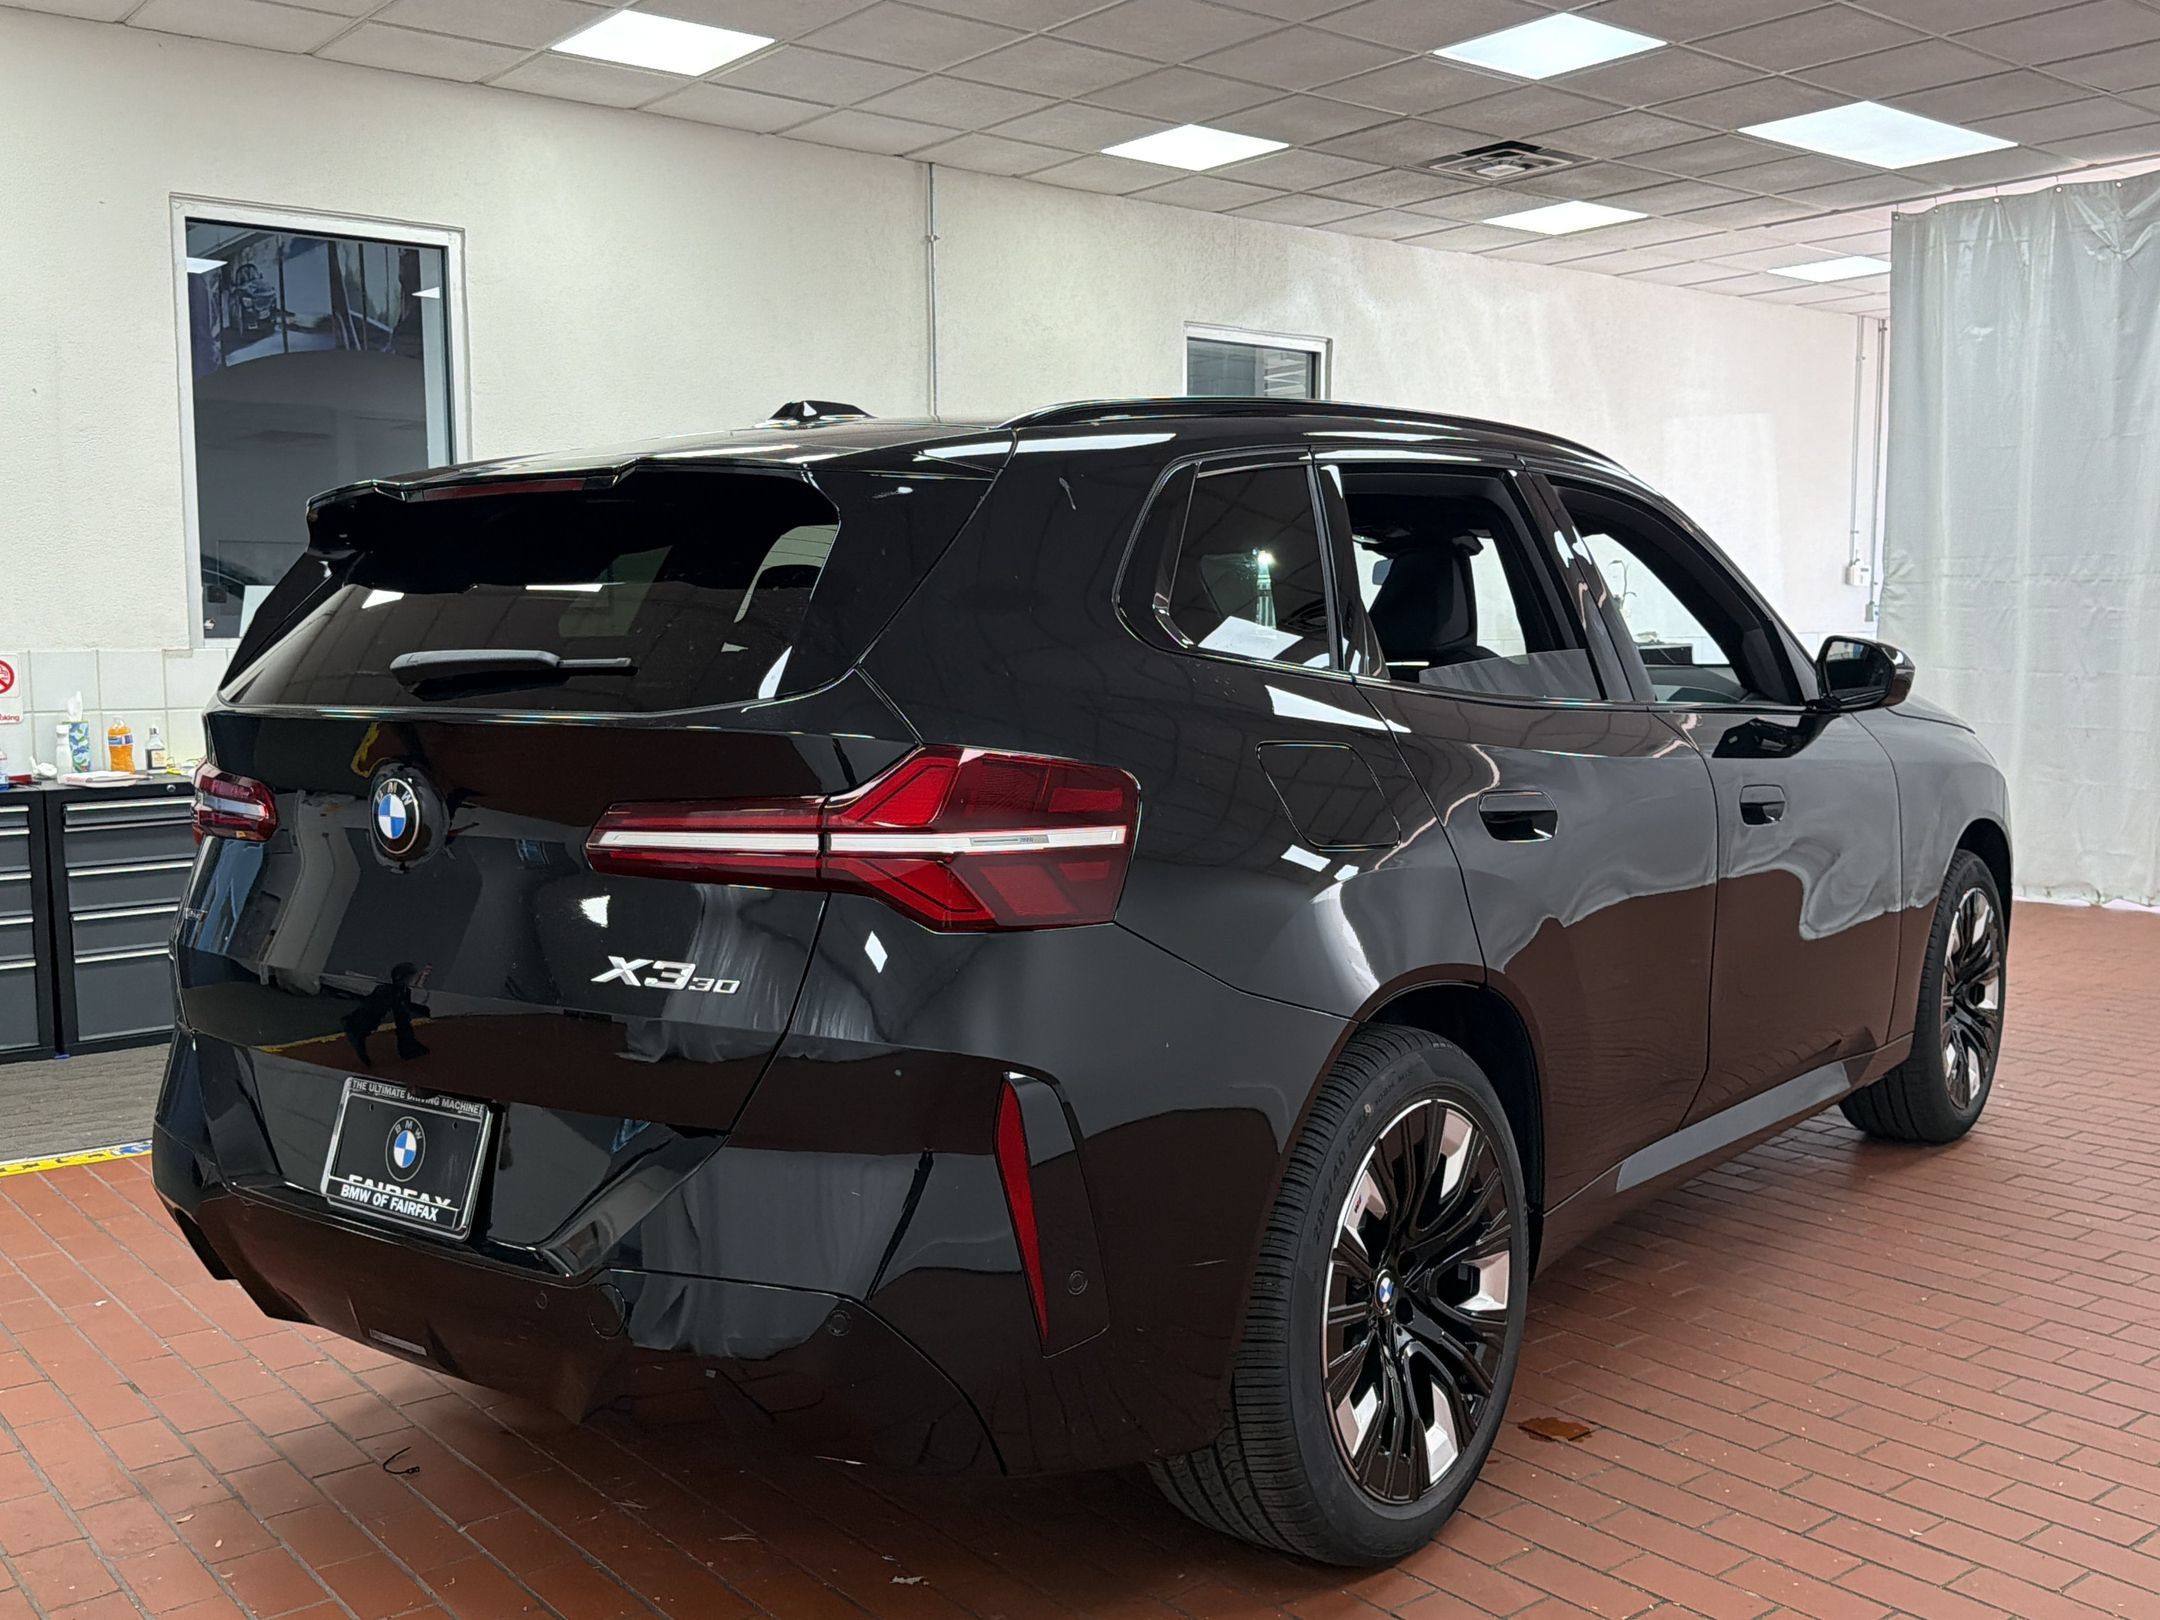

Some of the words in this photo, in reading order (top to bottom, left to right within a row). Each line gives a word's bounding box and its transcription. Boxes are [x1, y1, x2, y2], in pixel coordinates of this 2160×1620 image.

[376, 781, 413, 806] BMW
[590, 955, 696, 990] X3
[688, 976, 741, 994] 30
[352, 1079, 367, 1091] THE
[368, 1083, 406, 1099] ULTIMATE
[441, 1098, 480, 1114] MACHINE
[395, 1119, 423, 1140] BMW
[340, 1183, 372, 1203] BMW
[372, 1192, 390, 1208] OF
[389, 1197, 439, 1222] FAIRFAX
